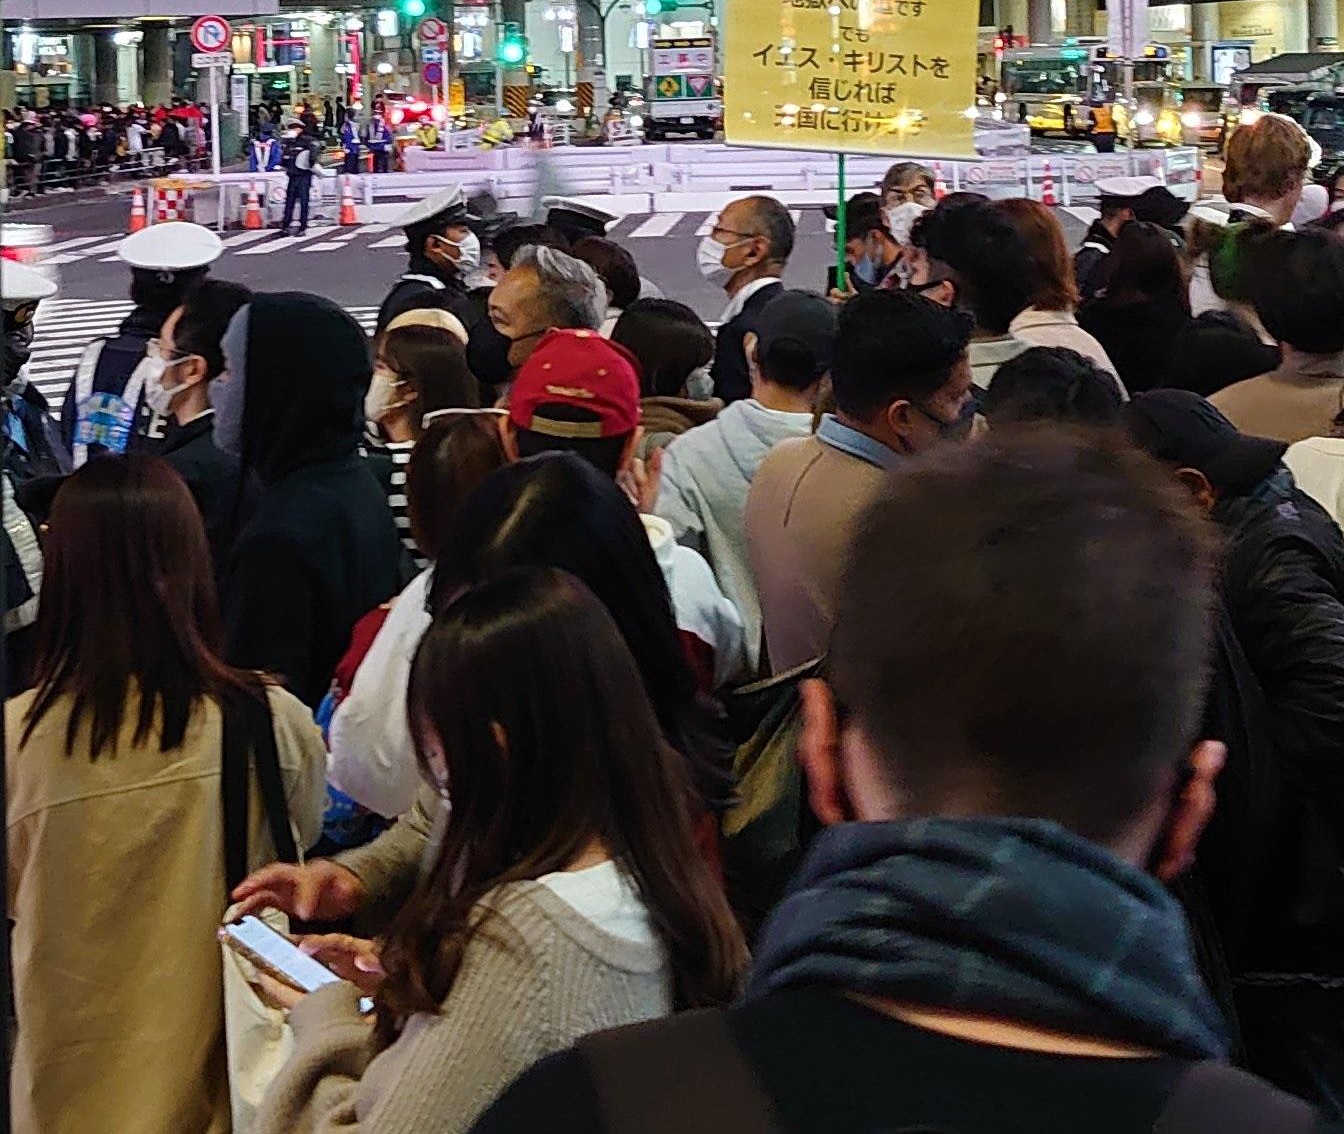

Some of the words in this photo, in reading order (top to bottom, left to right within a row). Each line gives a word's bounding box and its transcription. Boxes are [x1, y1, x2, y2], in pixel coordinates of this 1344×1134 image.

[838, 25, 872, 44] でも
[752, 43, 951, 80] イエス・キリストを
[809, 77, 898, 105] 信じれば
